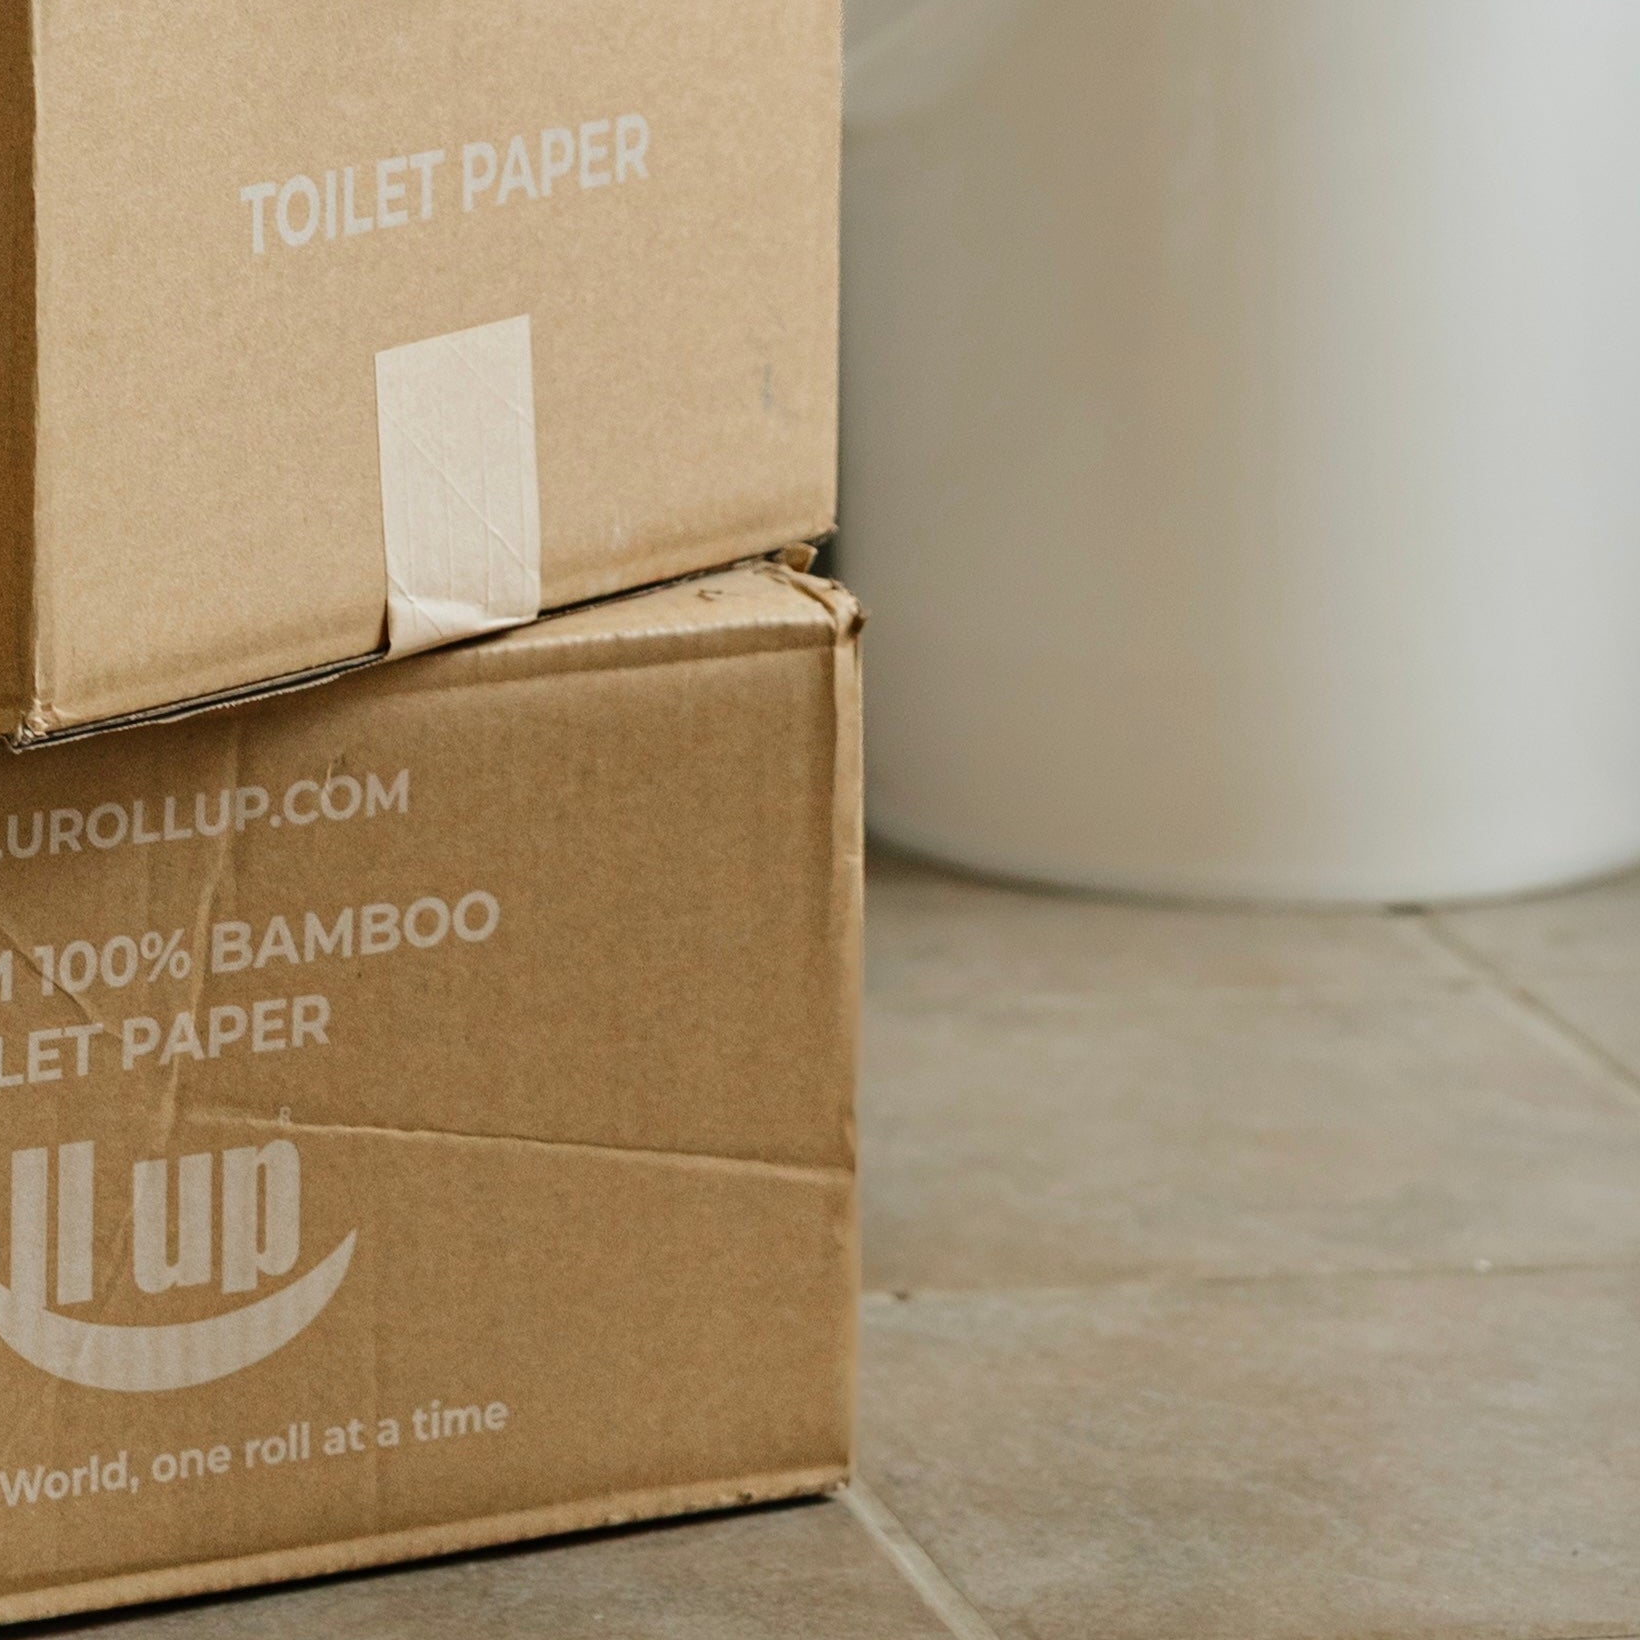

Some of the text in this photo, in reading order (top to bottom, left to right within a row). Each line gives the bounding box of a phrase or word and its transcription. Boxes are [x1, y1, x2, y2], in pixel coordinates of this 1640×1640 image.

[240, 112, 650, 255] TOILET PAPER
[33, 927, 192, 997] 100%
[210, 890, 502, 976] BAMBOO
[120, 994, 331, 1071] PAPER
[132, 1138, 302, 1296] up
[151, 1438, 233, 1484] one
[244, 1421, 311, 1467] roll
[322, 1419, 366, 1456] at
[377, 1416, 402, 1447] a
[411, 1397, 509, 1443] time
